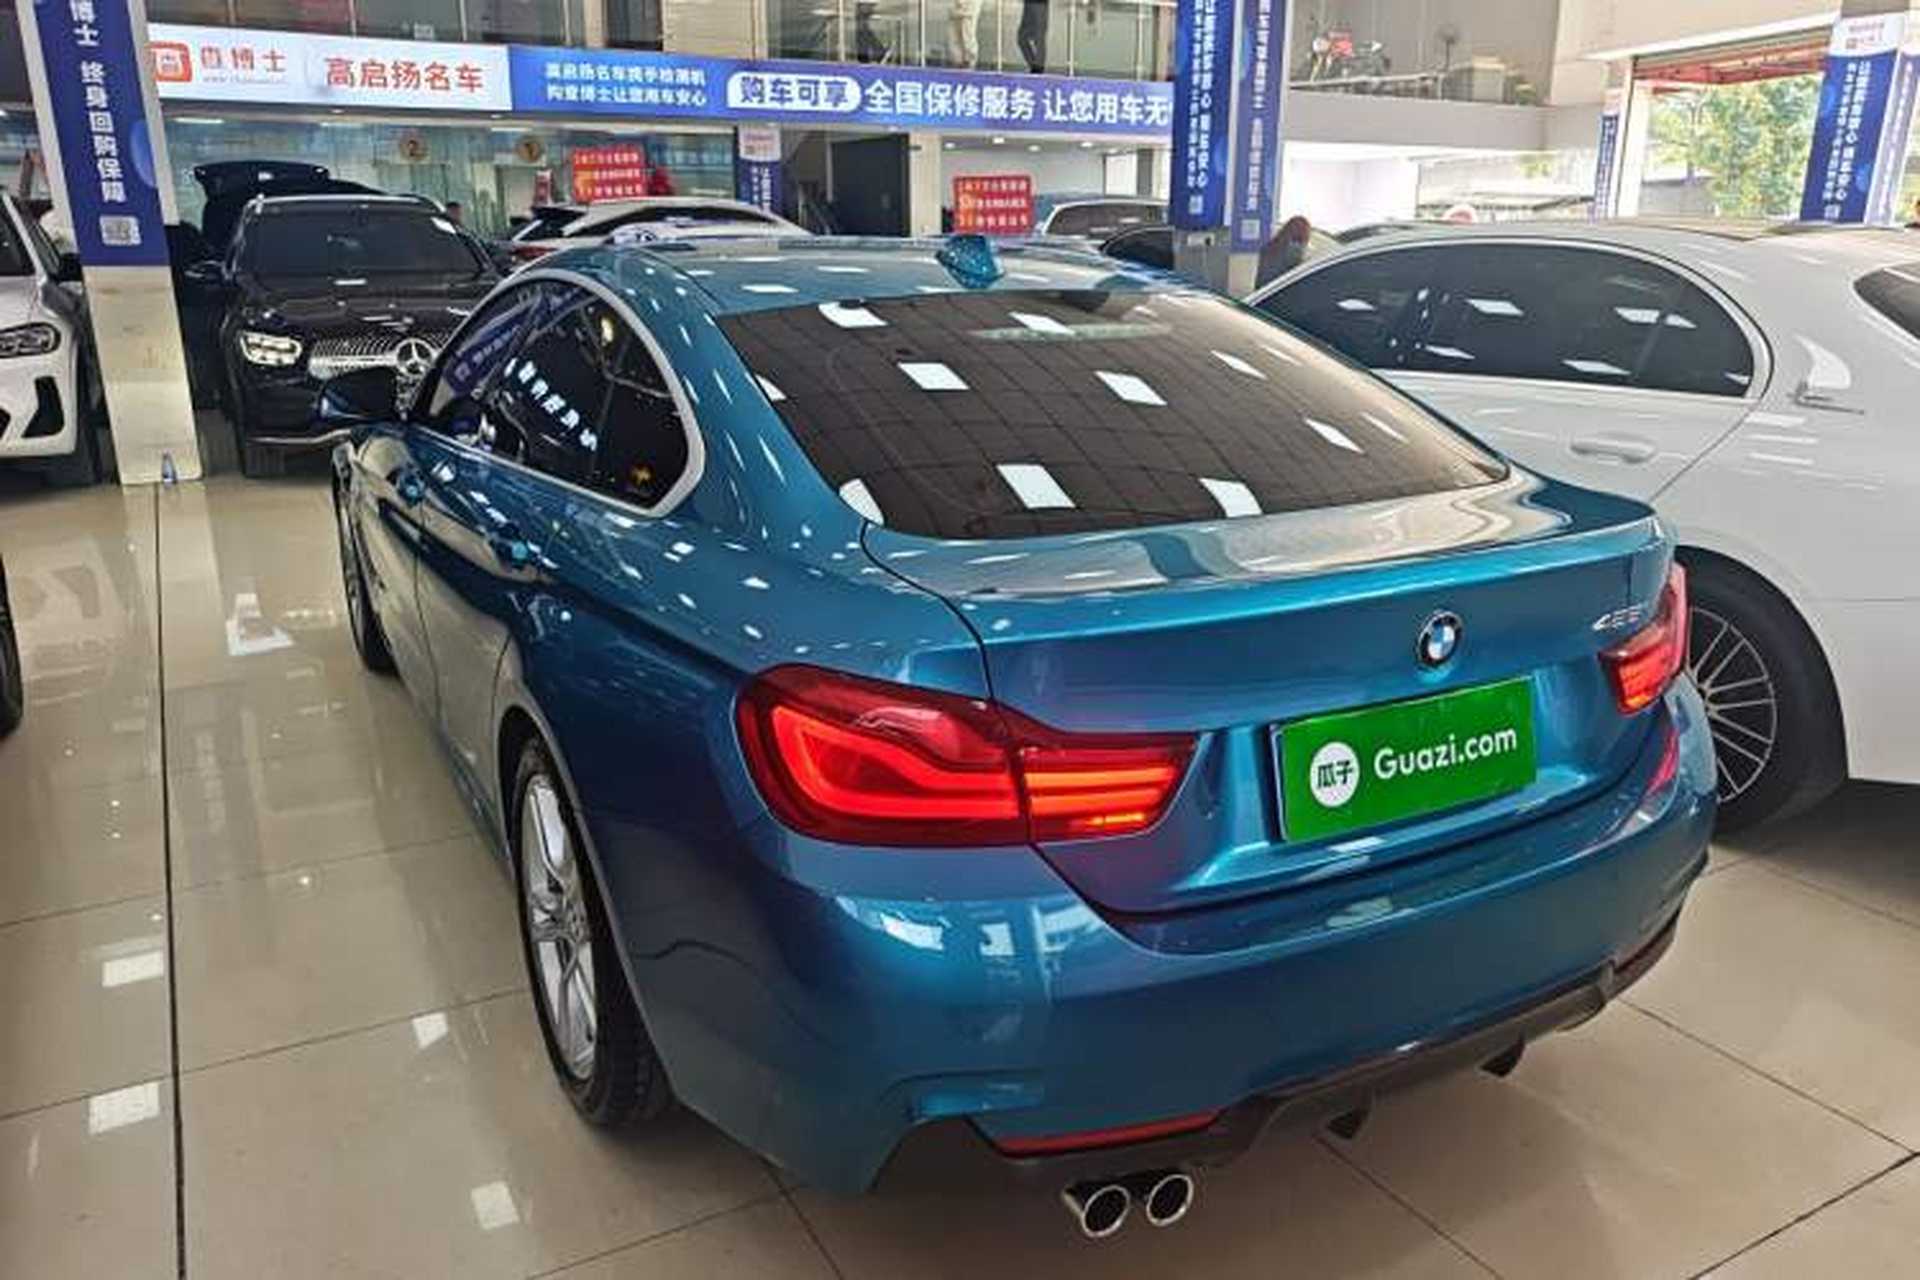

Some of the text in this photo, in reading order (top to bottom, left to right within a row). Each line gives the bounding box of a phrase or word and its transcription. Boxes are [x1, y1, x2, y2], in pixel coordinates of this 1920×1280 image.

[323, 57, 484, 94] 高启扬名车
[740, 75, 850, 108] 购车可享
[863, 79, 1174, 126] 全国保修服务 让您用车无
